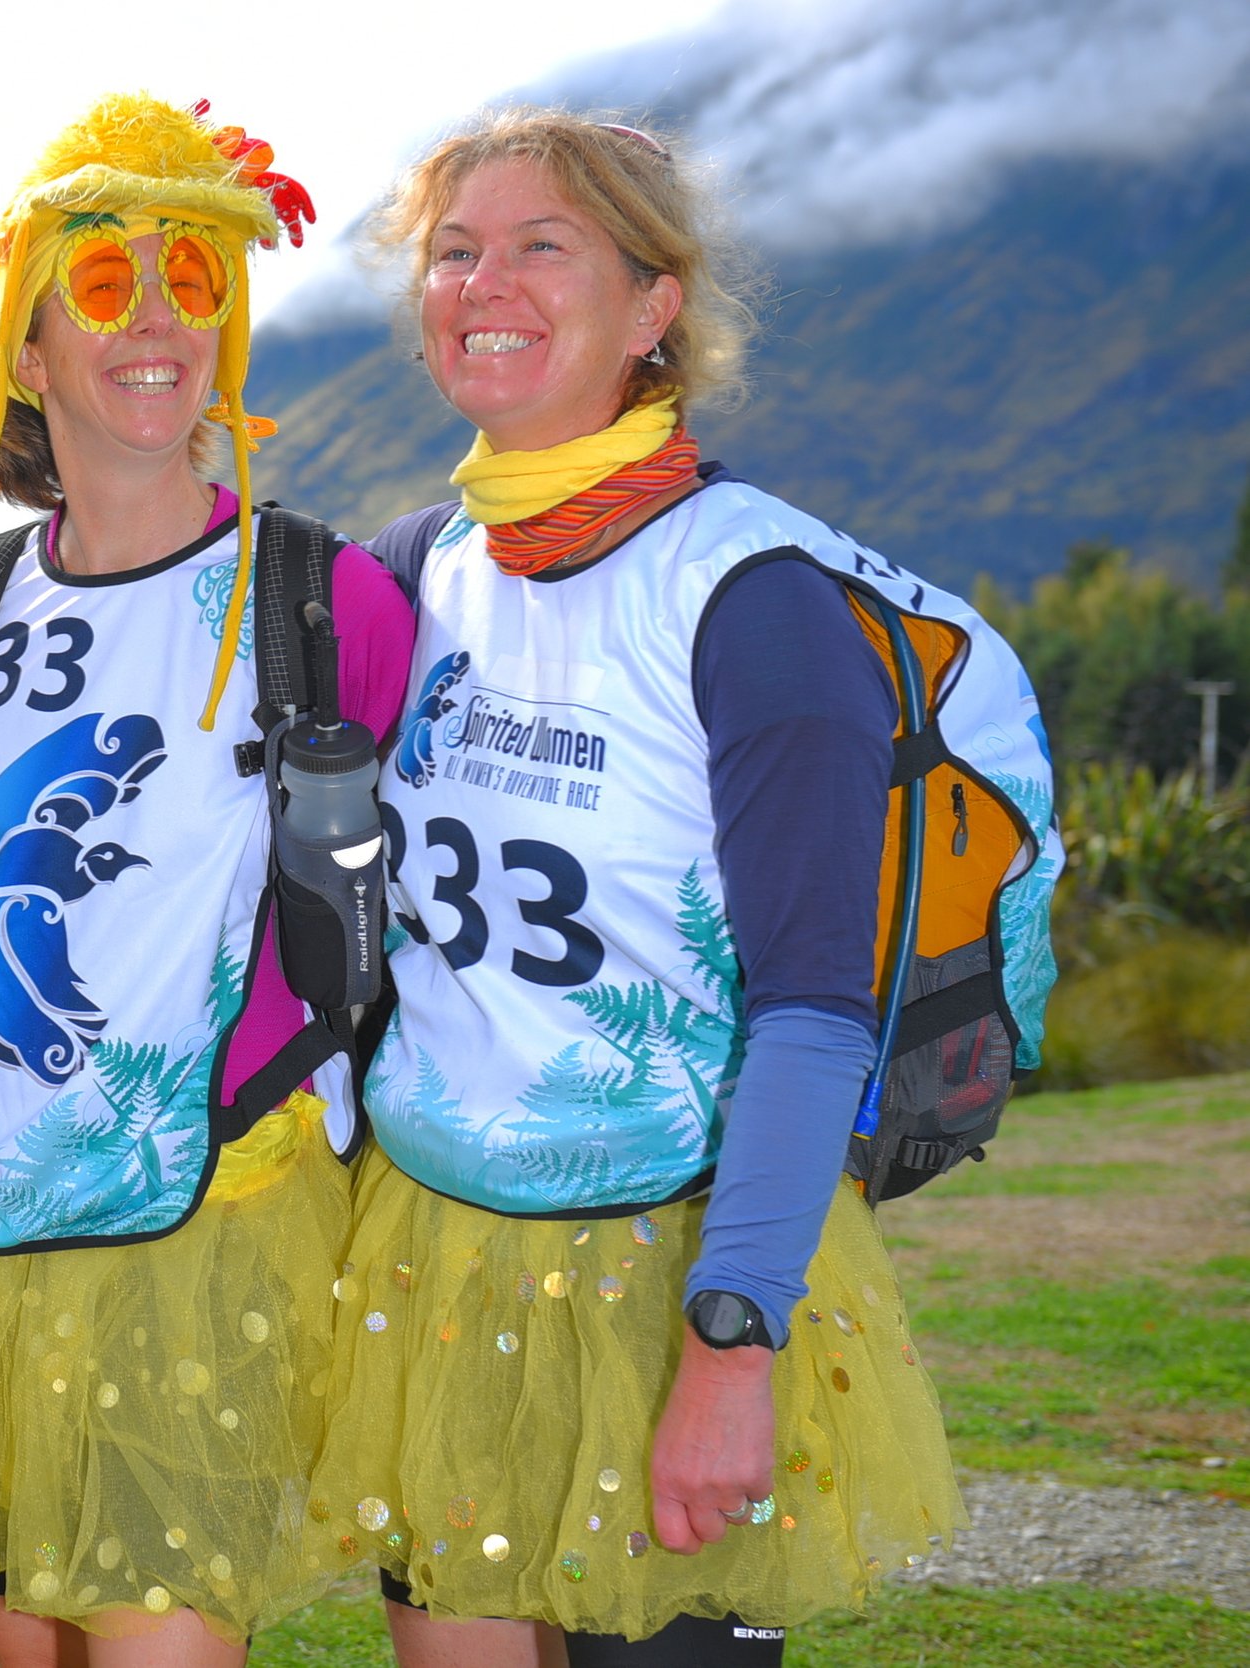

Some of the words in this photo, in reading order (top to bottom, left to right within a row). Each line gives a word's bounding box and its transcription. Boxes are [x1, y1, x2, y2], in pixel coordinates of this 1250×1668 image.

[438, 695, 537, 758] Spirited
[529, 716, 606, 772] Women
[443, 755, 462, 780] ALL
[461, 758, 505, 791] WOMEN'S
[502, 769, 562, 805] ADVENTURE
[565, 780, 602, 811] RACE
